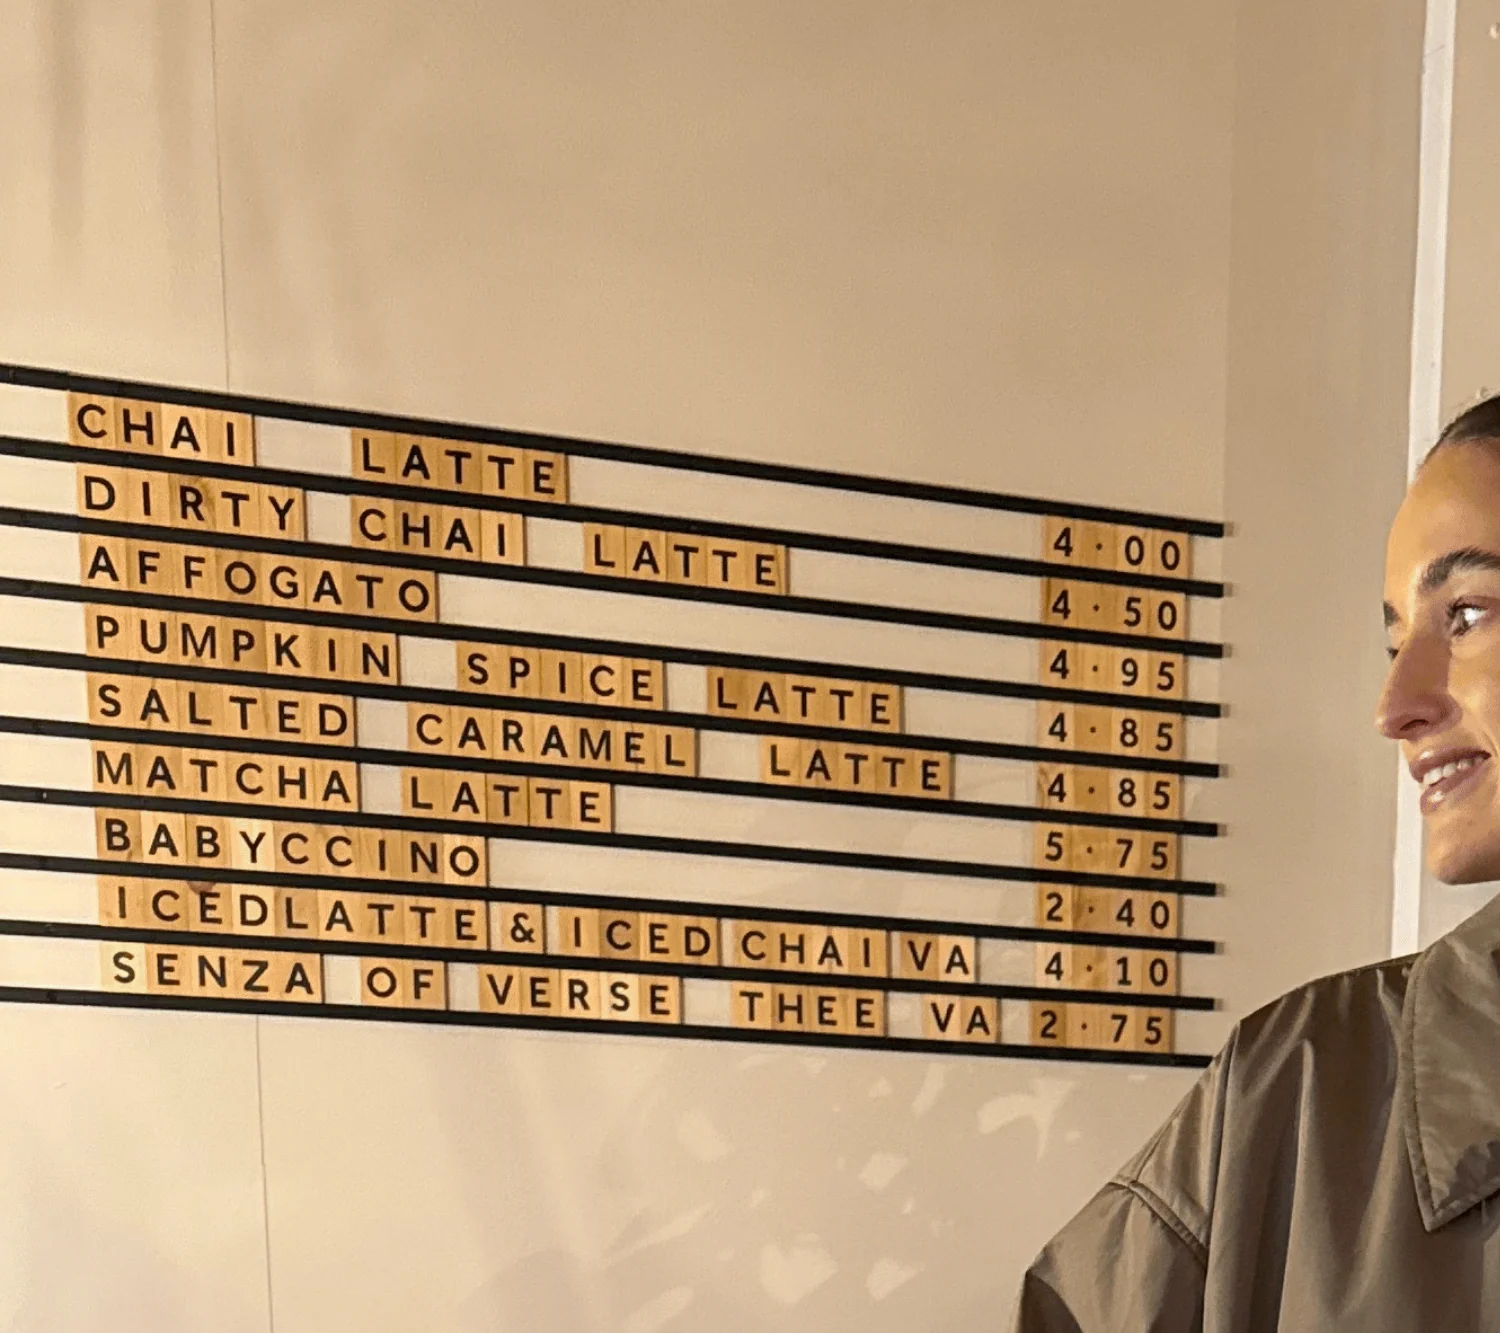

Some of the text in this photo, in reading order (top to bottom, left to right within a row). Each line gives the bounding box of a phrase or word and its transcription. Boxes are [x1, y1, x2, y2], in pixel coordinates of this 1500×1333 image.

[76, 403, 235, 458] CHAI
[361, 438, 556, 496] LATTE
[84, 476, 296, 532] DIRTY
[359, 508, 507, 558] CHAI
[595, 537, 778, 587] LATTE
[88, 546, 430, 613] AFFOGATO
[97, 615, 391, 678] PUMPKIN
[467, 652, 653, 703] SPICE
[718, 678, 891, 725] LATTE
[99, 684, 348, 737] SALTED
[416, 713, 686, 768] CARAMEL
[770, 744, 942, 792] LATTE
[97, 750, 352, 805] MATCHA
[410, 777, 601, 824] LATTE
[105, 818, 480, 878] BABYCCINO
[509, 911, 536, 942] &
[573, 917, 712, 957] ICED
[741, 931, 872, 969] CHAI
[908, 941, 969, 977] VA
[112, 951, 313, 994] SENZA
[367, 966, 434, 1000] OF
[487, 974, 671, 1017] VERSE
[740, 990, 876, 1029] THEE
[931, 1002, 990, 1037] VA
